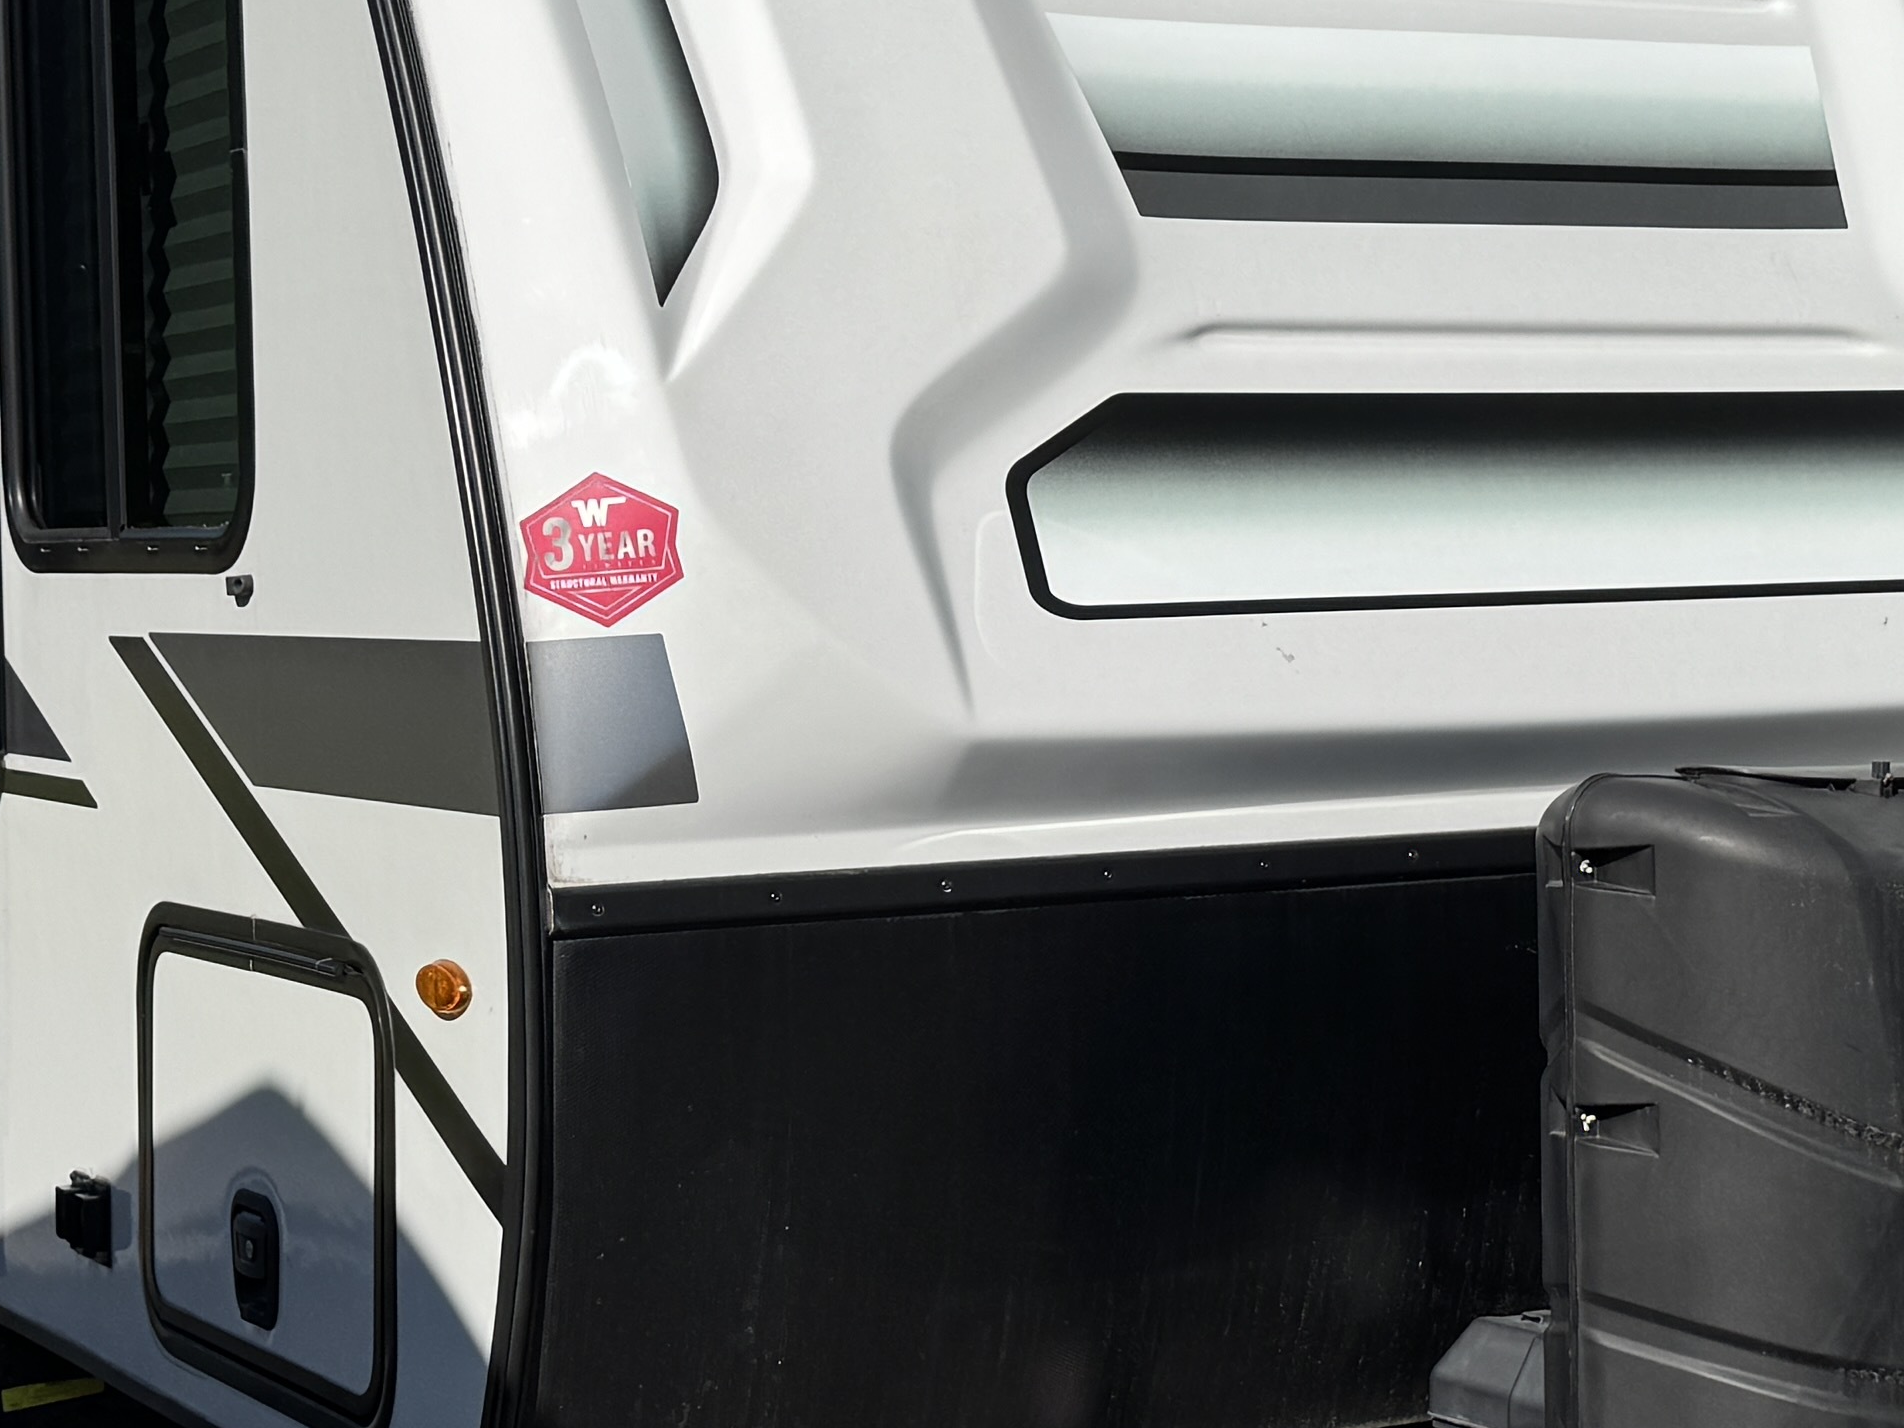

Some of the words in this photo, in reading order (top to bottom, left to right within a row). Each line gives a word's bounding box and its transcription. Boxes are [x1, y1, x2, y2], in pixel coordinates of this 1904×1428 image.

[542, 516, 574, 572] 3
[577, 528, 657, 562] YEAR
[549, 576, 607, 590] STRUCTURAL
[609, 572, 658, 585] WARRANTY
